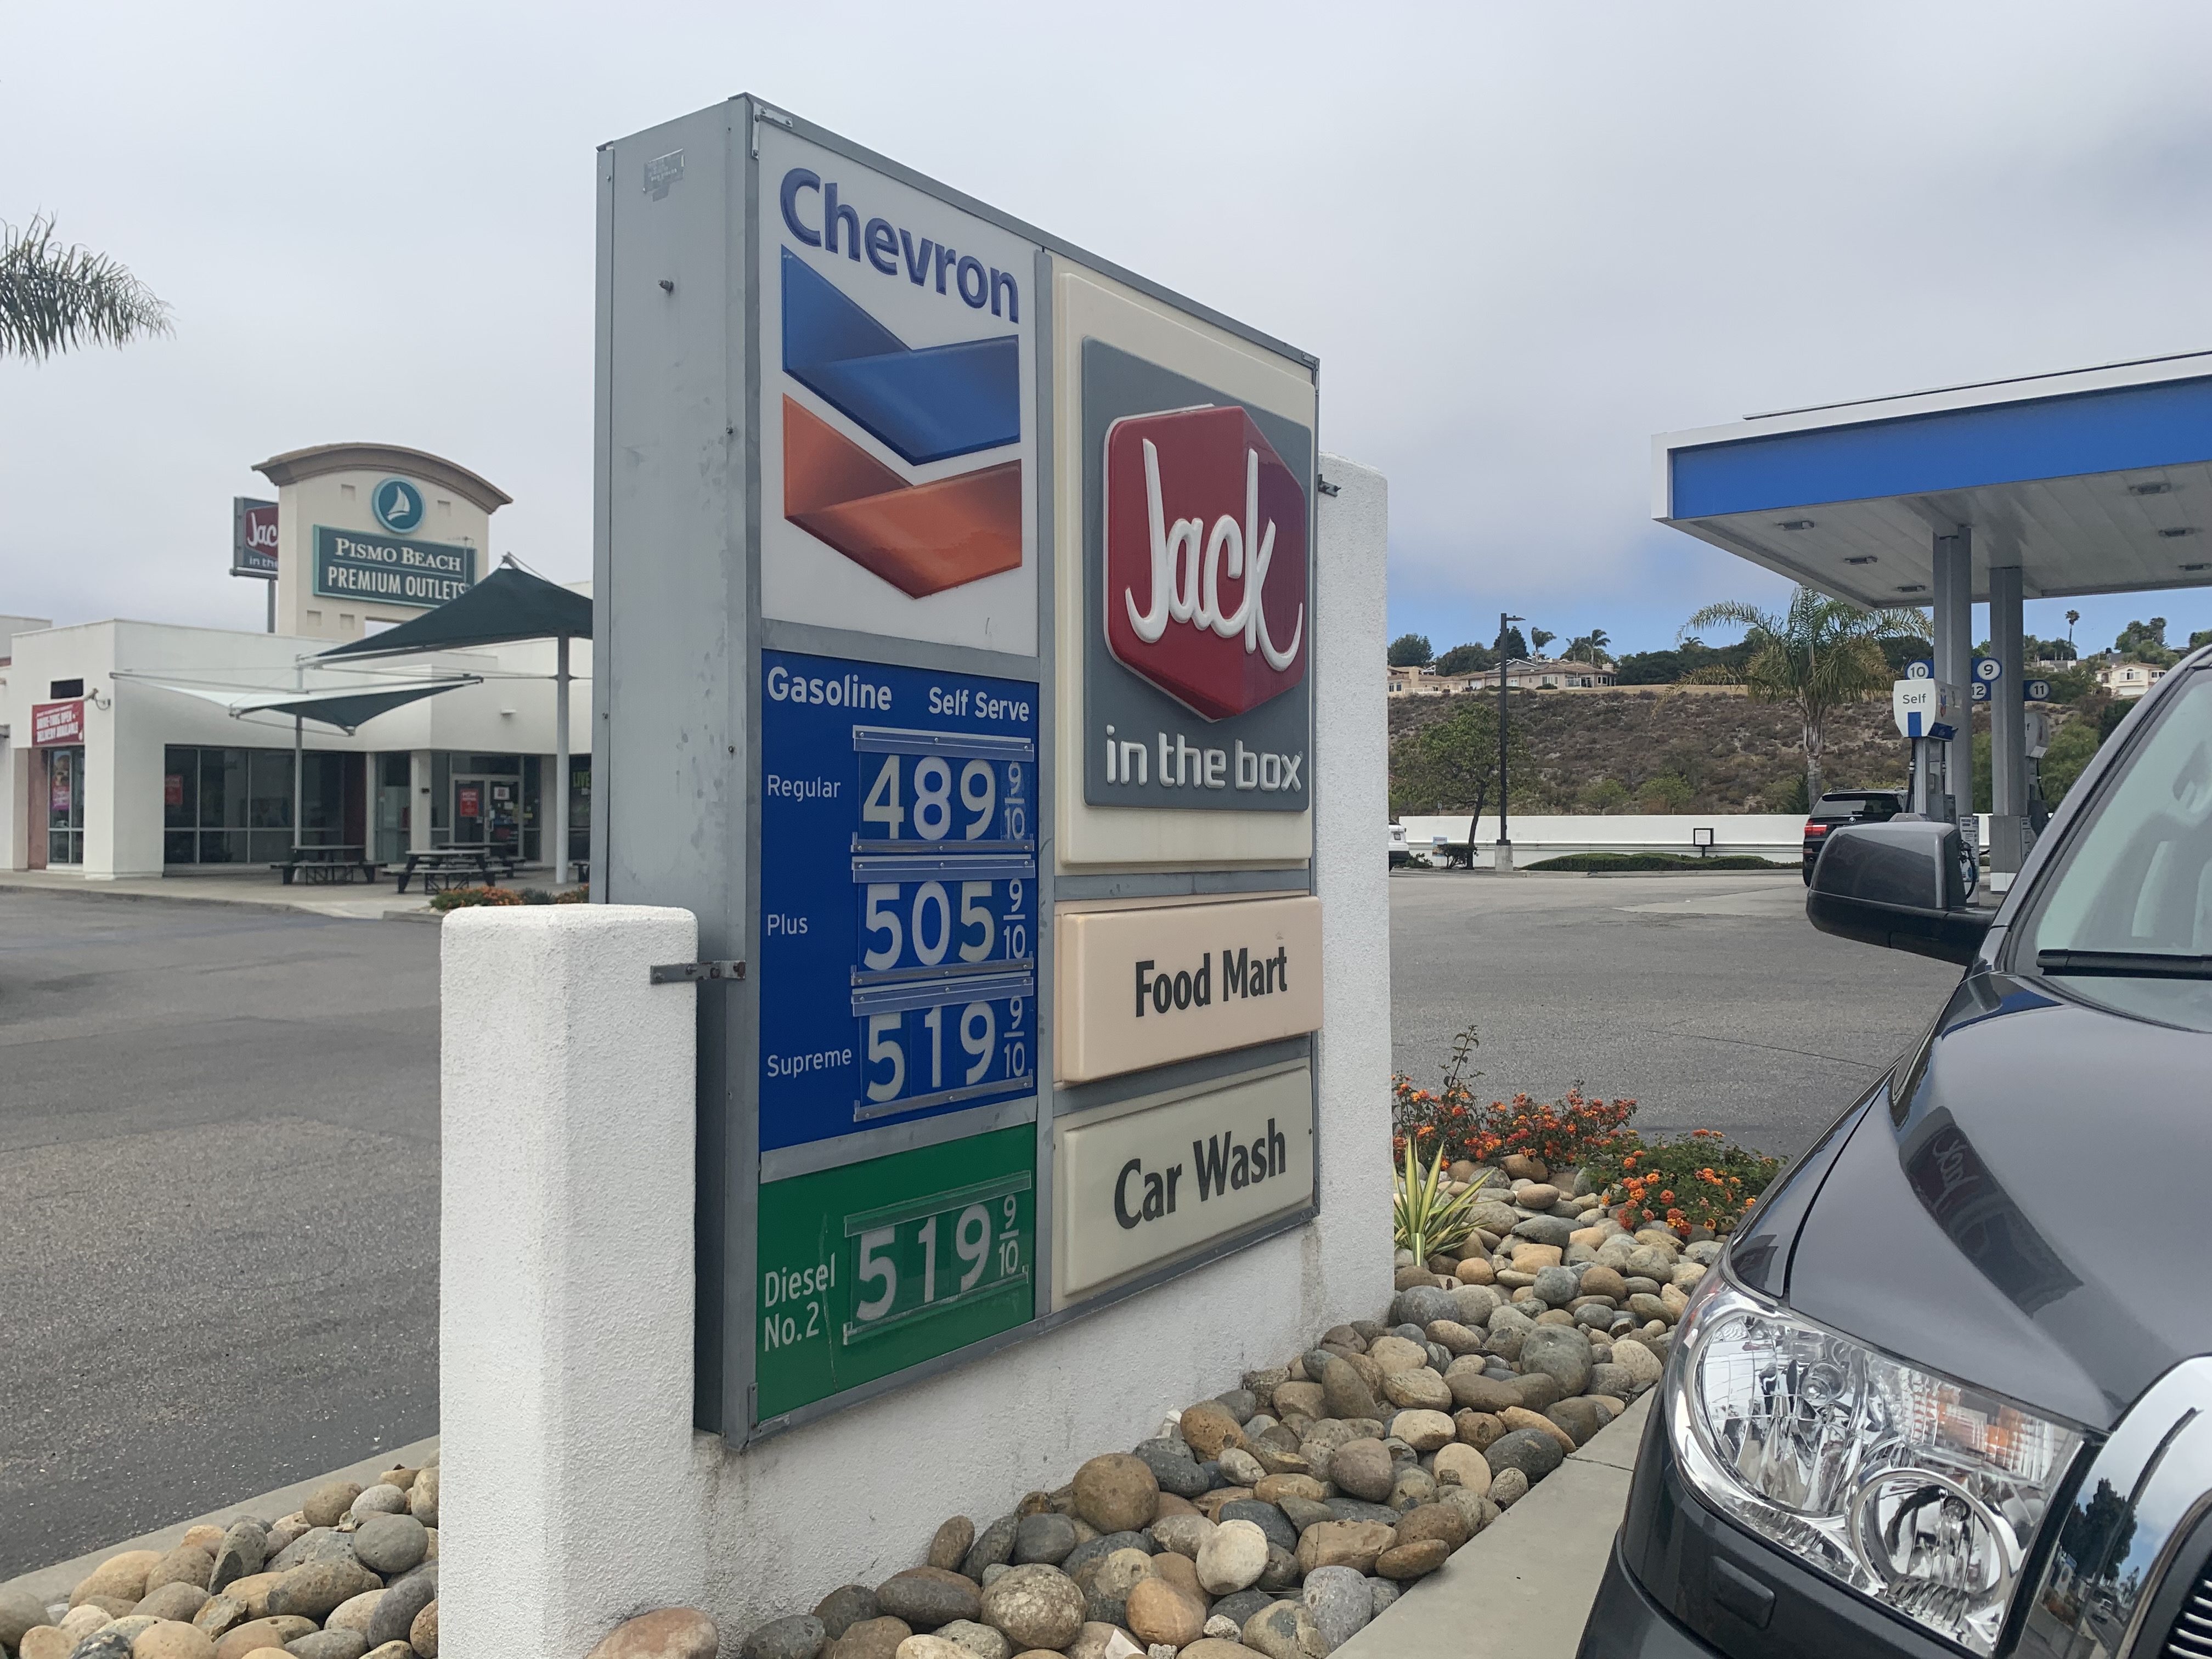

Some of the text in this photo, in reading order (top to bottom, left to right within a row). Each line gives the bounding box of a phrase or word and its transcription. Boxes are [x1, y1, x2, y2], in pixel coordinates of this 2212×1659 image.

[780, 167, 1019, 325] Chevron
[247, 511, 278, 547] Jac
[335, 538, 461, 572] PISMO BEACH
[1125, 438, 1303, 672] Jack
[249, 556, 261, 566] in
[328, 566, 401, 595] PREMIUM
[768, 667, 1030, 722] Gasoline Self Serve
[1910, 667, 1926, 678] 10
[1972, 686, 1984, 696] 12
[1984, 664, 1994, 676] 9
[2034, 685, 2045, 695] 11
[1903, 693, 1927, 704] Self
[1106, 725, 1301, 793] in the box
[768, 775, 840, 802] Regular
[863, 754, 996, 840] 489
[768, 913, 808, 936] Plus
[864, 881, 995, 970] 505
[1135, 946, 1288, 1018] Food Mart
[768, 1048, 852, 1079] Supreme
[866, 1000, 996, 1102] 519
[1114, 1118, 1286, 1229] Car Wash
[765, 1252, 836, 1308] Diesel
[856, 1204, 991, 1321] 519
[765, 1301, 819, 1352] No.2
